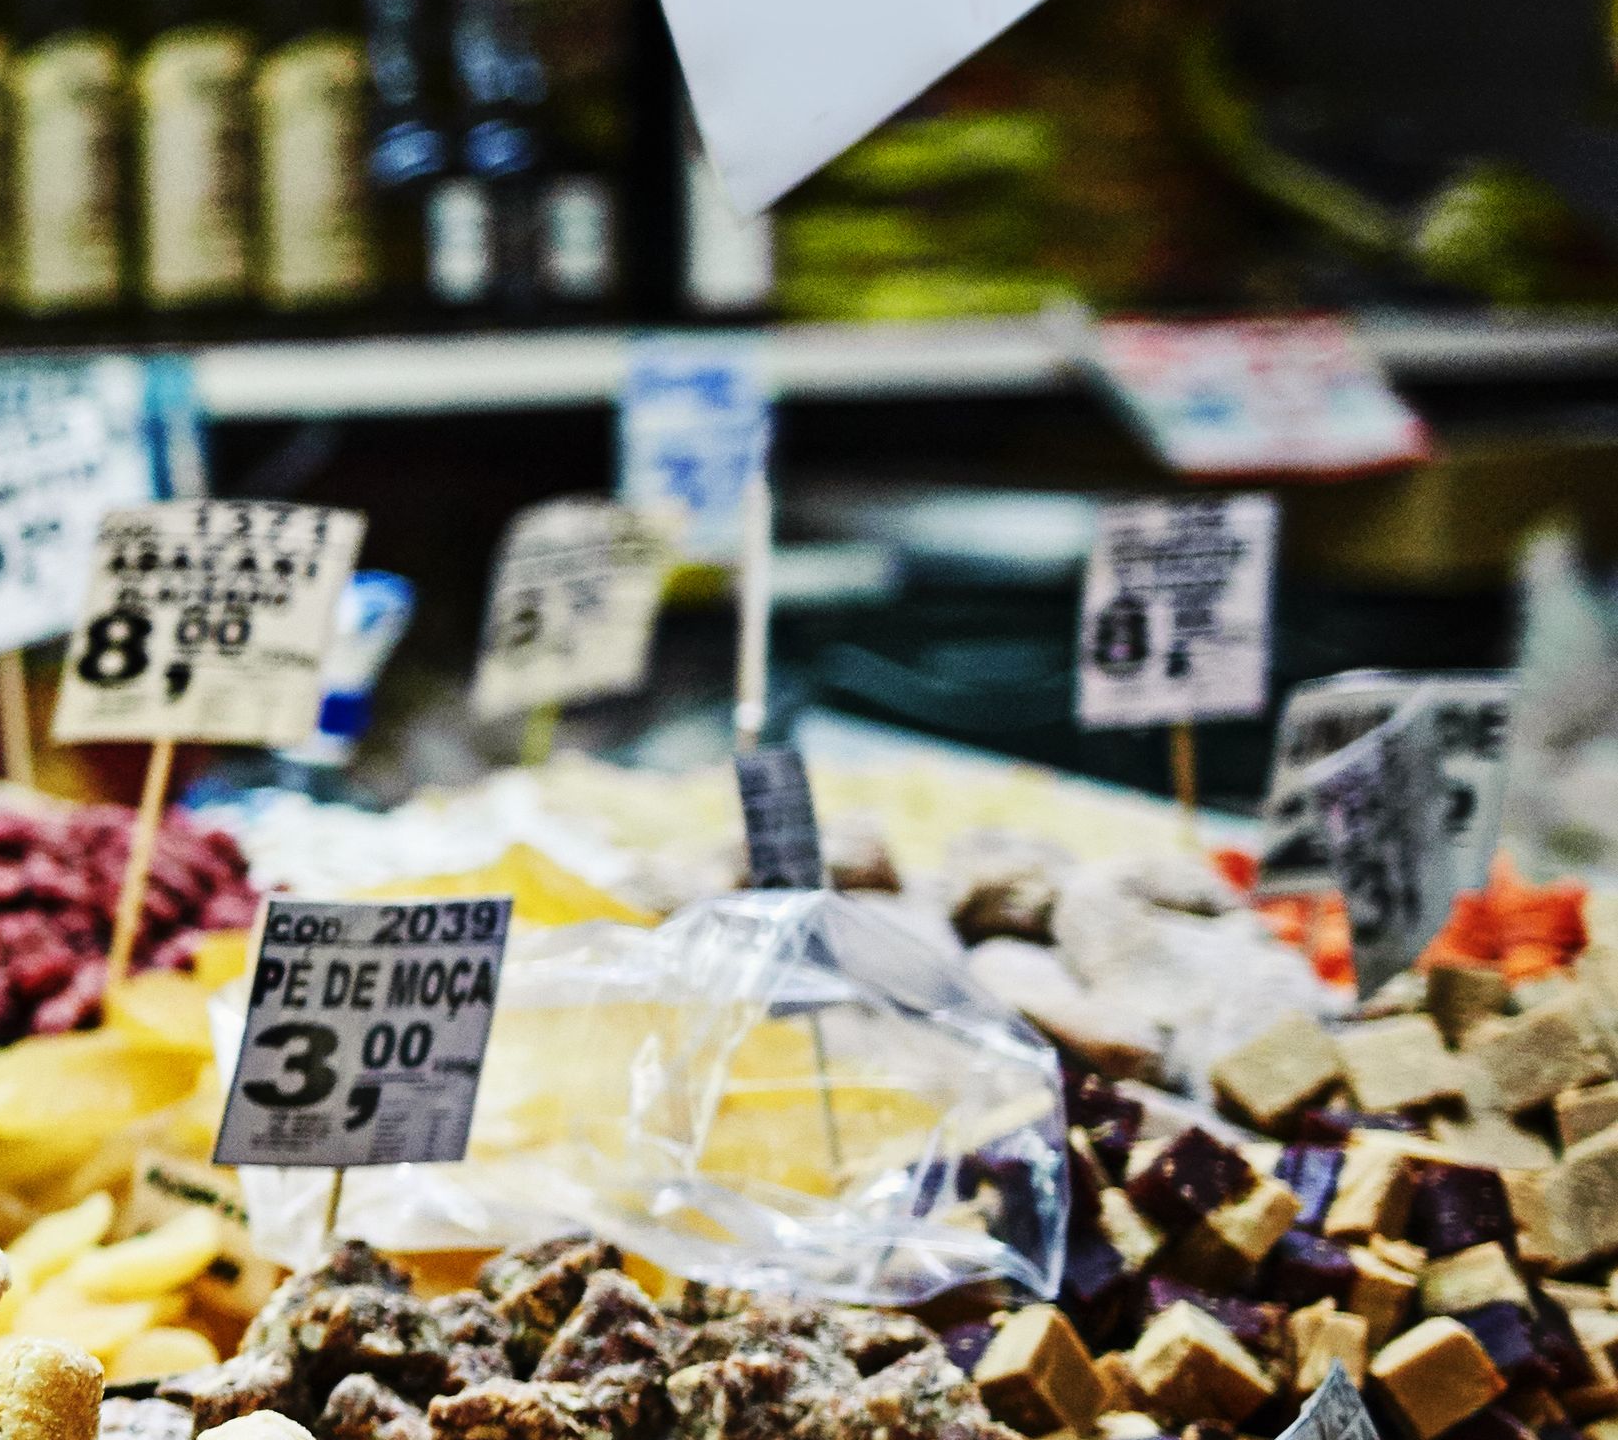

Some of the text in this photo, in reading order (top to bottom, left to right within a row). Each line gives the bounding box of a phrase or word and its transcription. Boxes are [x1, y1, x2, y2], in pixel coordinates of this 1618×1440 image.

[373, 902, 500, 945] 2039
[321, 961, 379, 1010] DE
[387, 959, 495, 1021] MOÇA
